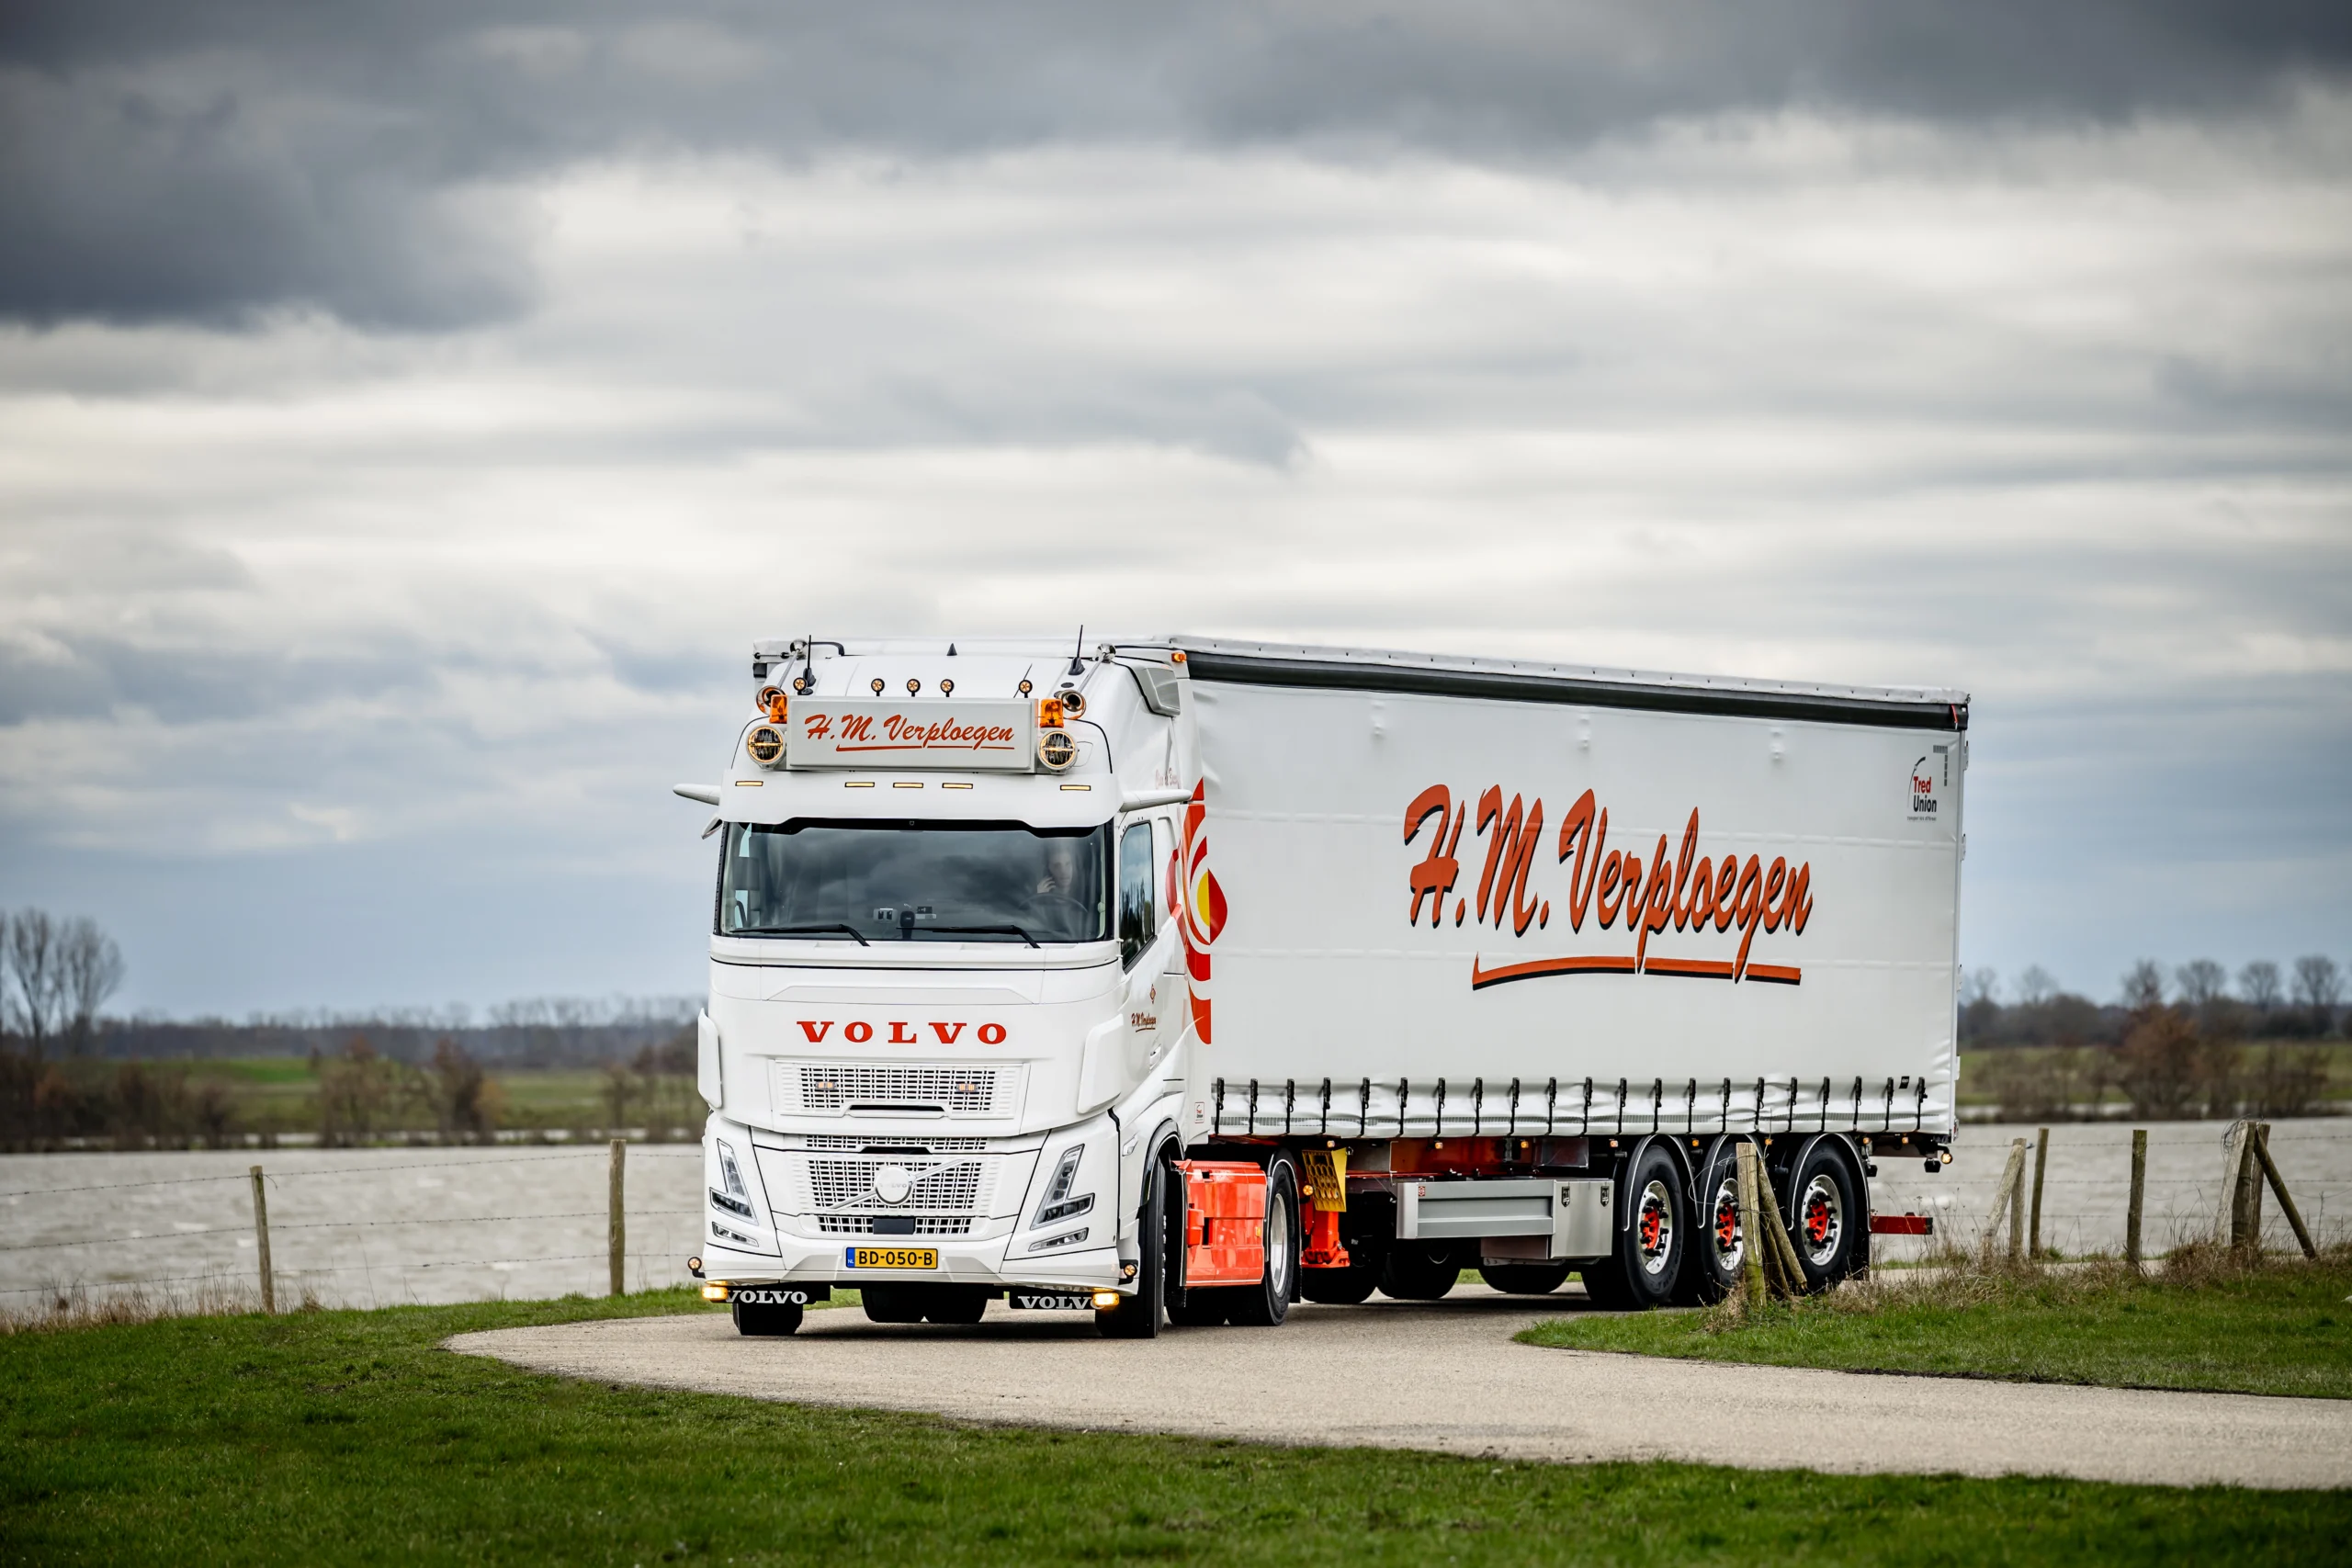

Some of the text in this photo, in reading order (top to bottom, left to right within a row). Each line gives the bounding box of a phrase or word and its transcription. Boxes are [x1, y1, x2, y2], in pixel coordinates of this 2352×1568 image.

[883, 714, 1014, 750] Verploegen
[1913, 775, 1932, 794] Tred
[1913, 795, 1937, 812] Union
[1558, 788, 1814, 984] Verploegen
[797, 1021, 1007, 1045] VOLVO
[858, 1250, 933, 1266] BD-050-B
